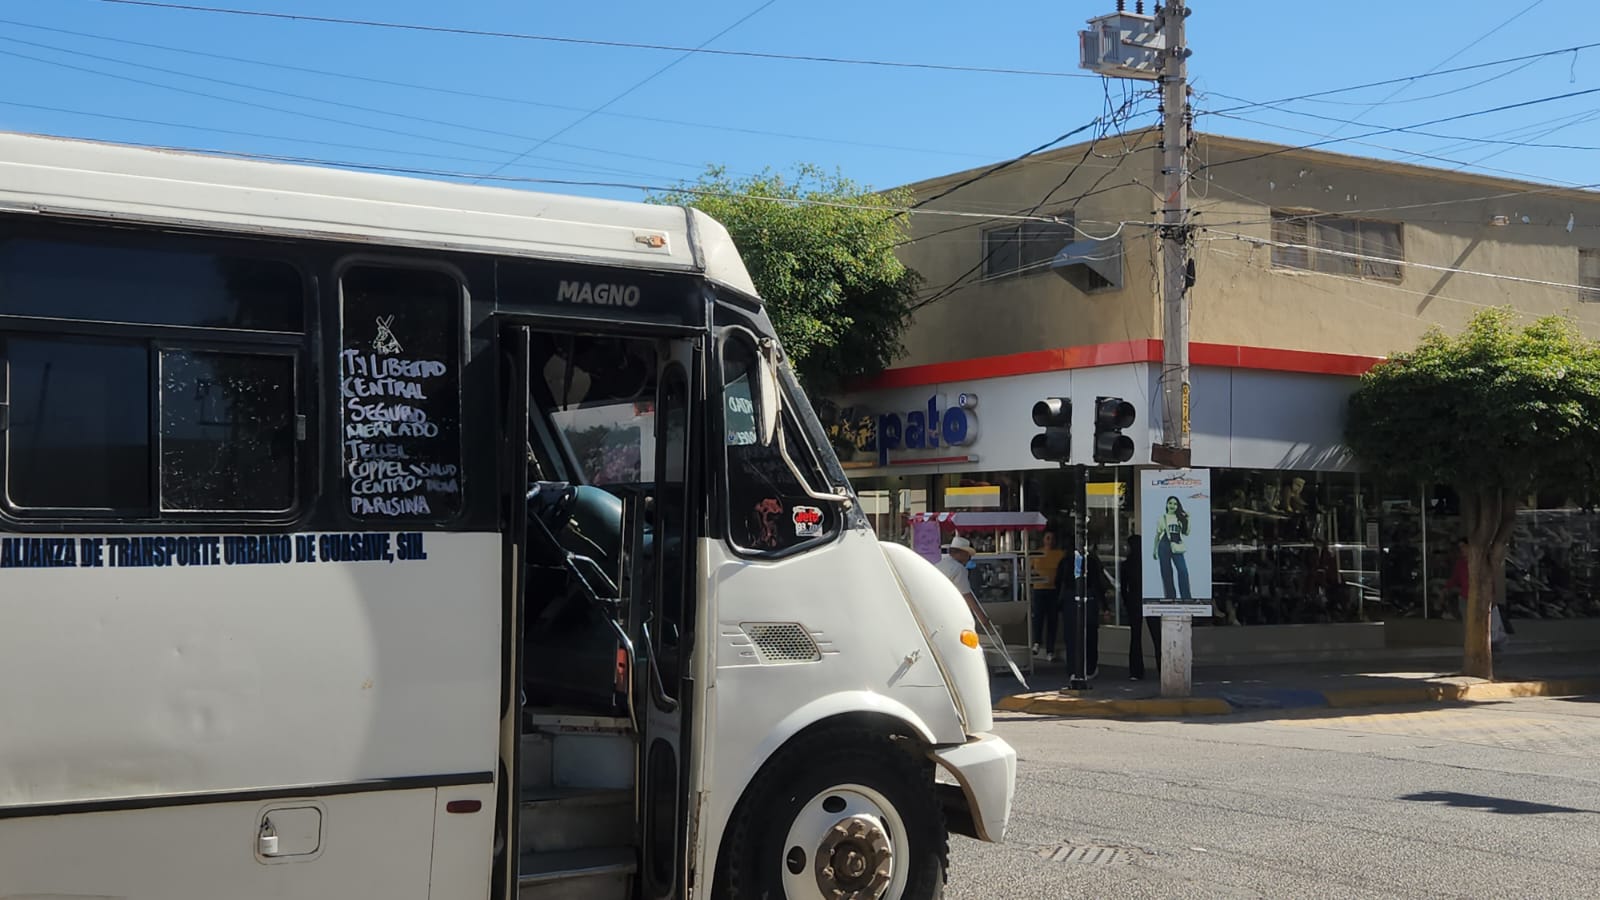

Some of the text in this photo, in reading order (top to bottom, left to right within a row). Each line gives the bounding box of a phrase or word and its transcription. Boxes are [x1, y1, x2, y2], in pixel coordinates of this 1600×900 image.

[557, 280, 640, 307] MAGNO
[342, 376, 427, 399] CENTRAL
[348, 460, 409, 479] COPPEL
[351, 496, 431, 516] PARISINA
[1, 537, 77, 568] ALIANZA
[80, 537, 104, 567] DE
[106, 536, 221, 567] TRANSPORTE
[224, 534, 292, 566] URBANO
[295, 534, 317, 564] DE
[319, 533, 394, 564] GUASAVE,
